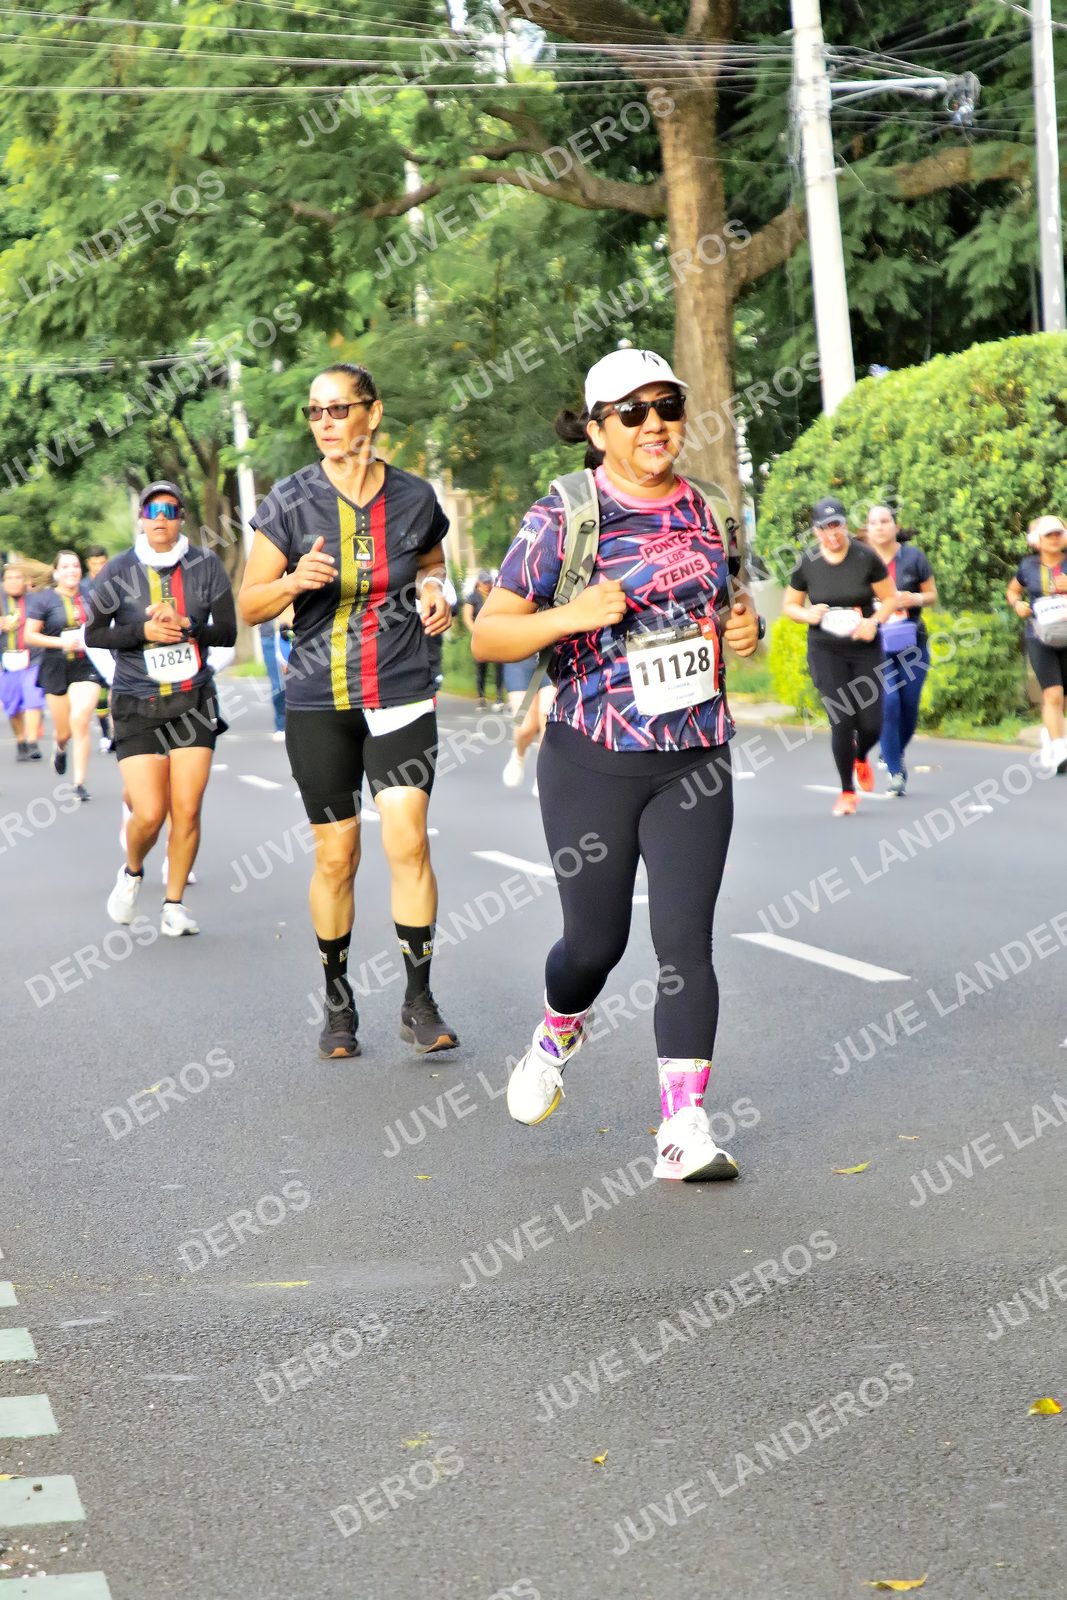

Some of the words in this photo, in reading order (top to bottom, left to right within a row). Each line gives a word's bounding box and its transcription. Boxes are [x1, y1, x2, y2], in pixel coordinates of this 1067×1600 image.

[644, 532, 689, 558] PONTE
[667, 551, 685, 564] LOS
[659, 559, 705, 586] TENIS
[151, 647, 192, 669] 12824
[636, 646, 710, 686] 11128
